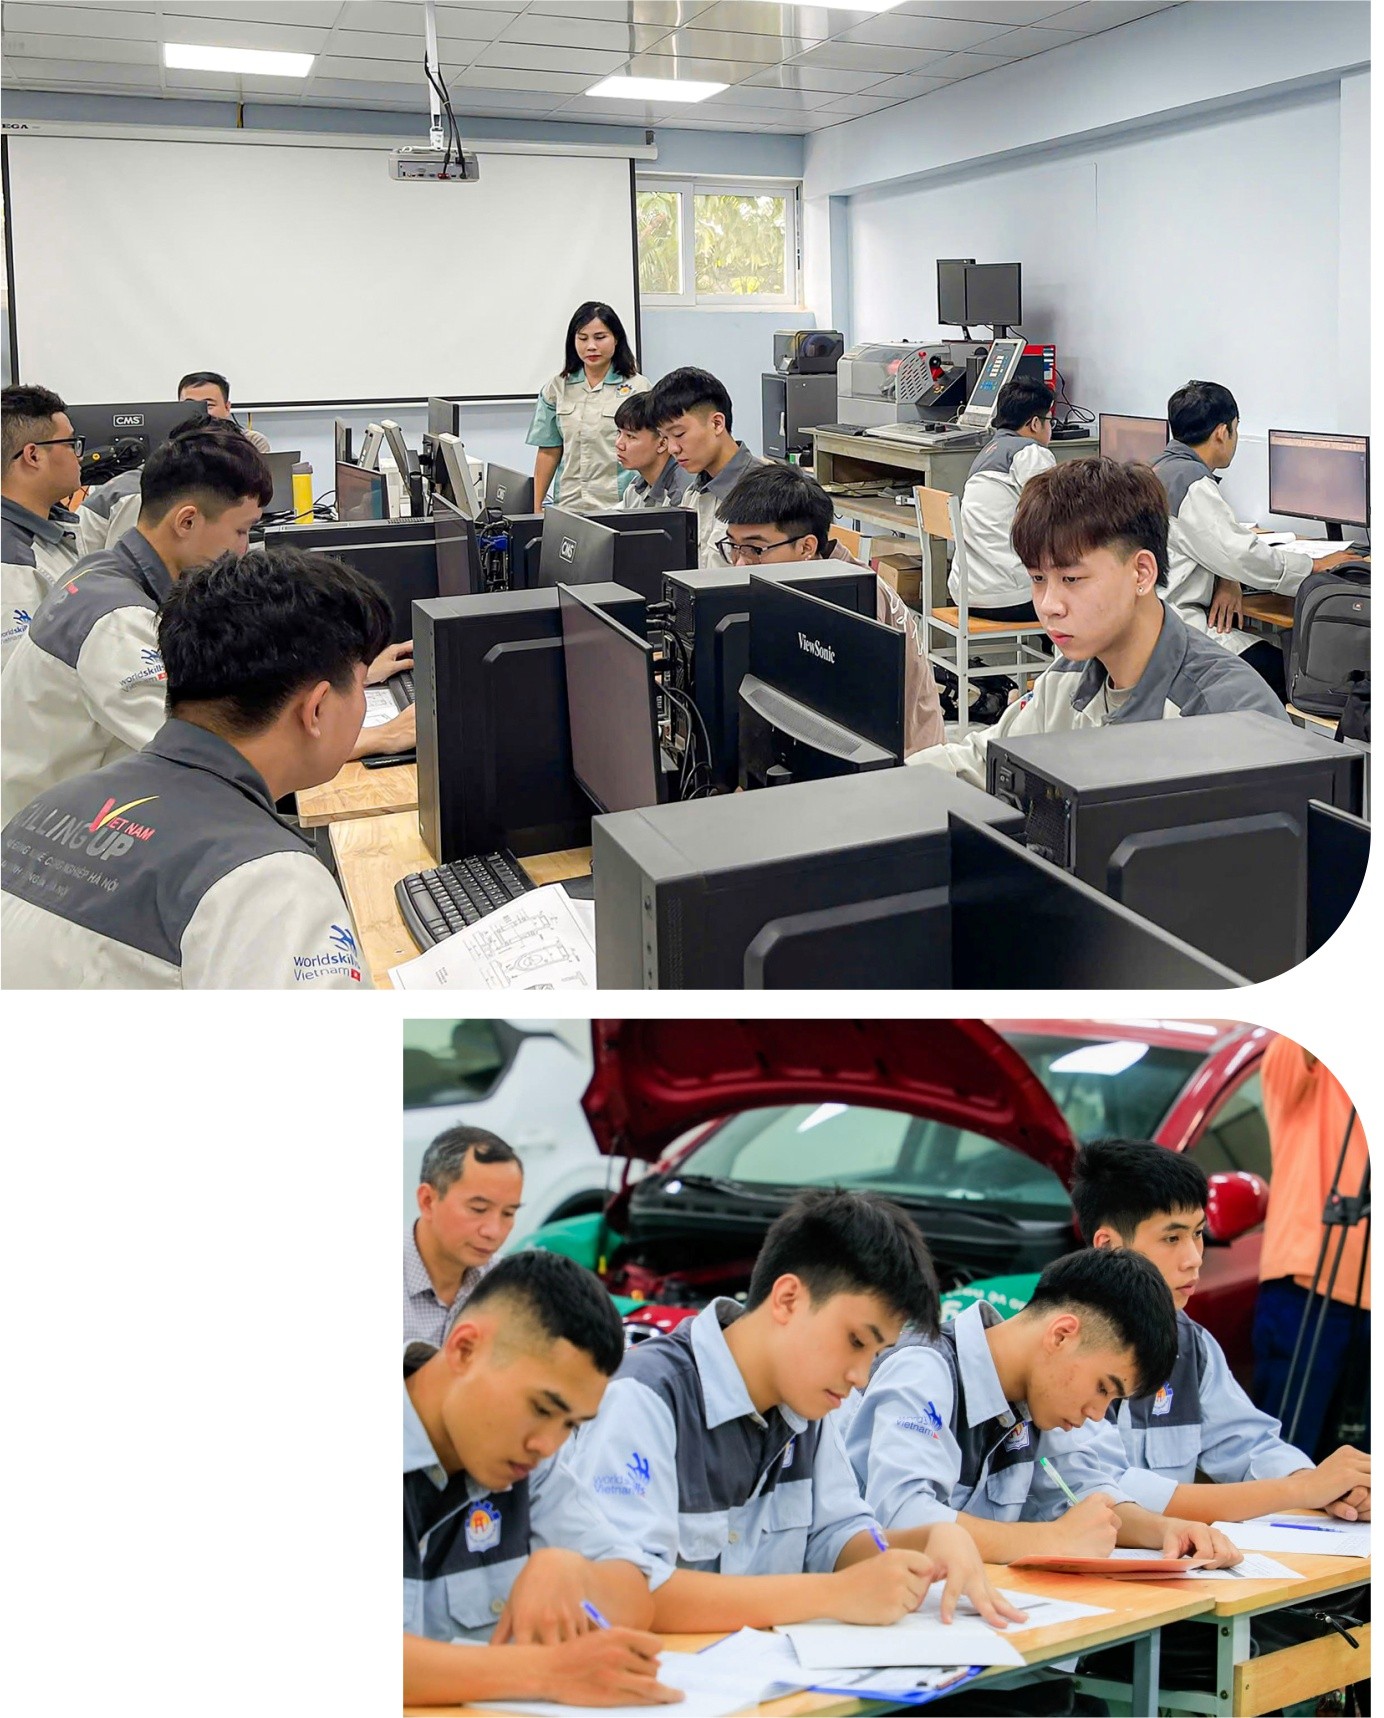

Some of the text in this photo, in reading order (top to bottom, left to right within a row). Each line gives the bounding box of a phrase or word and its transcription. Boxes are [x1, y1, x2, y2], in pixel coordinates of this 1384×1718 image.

[116, 416, 141, 425] CMS
[798, 631, 836, 664] ViewSonic
[125, 822, 156, 842] NAM
[85, 827, 135, 862] UP
[294, 967, 350, 981] Vietnam
